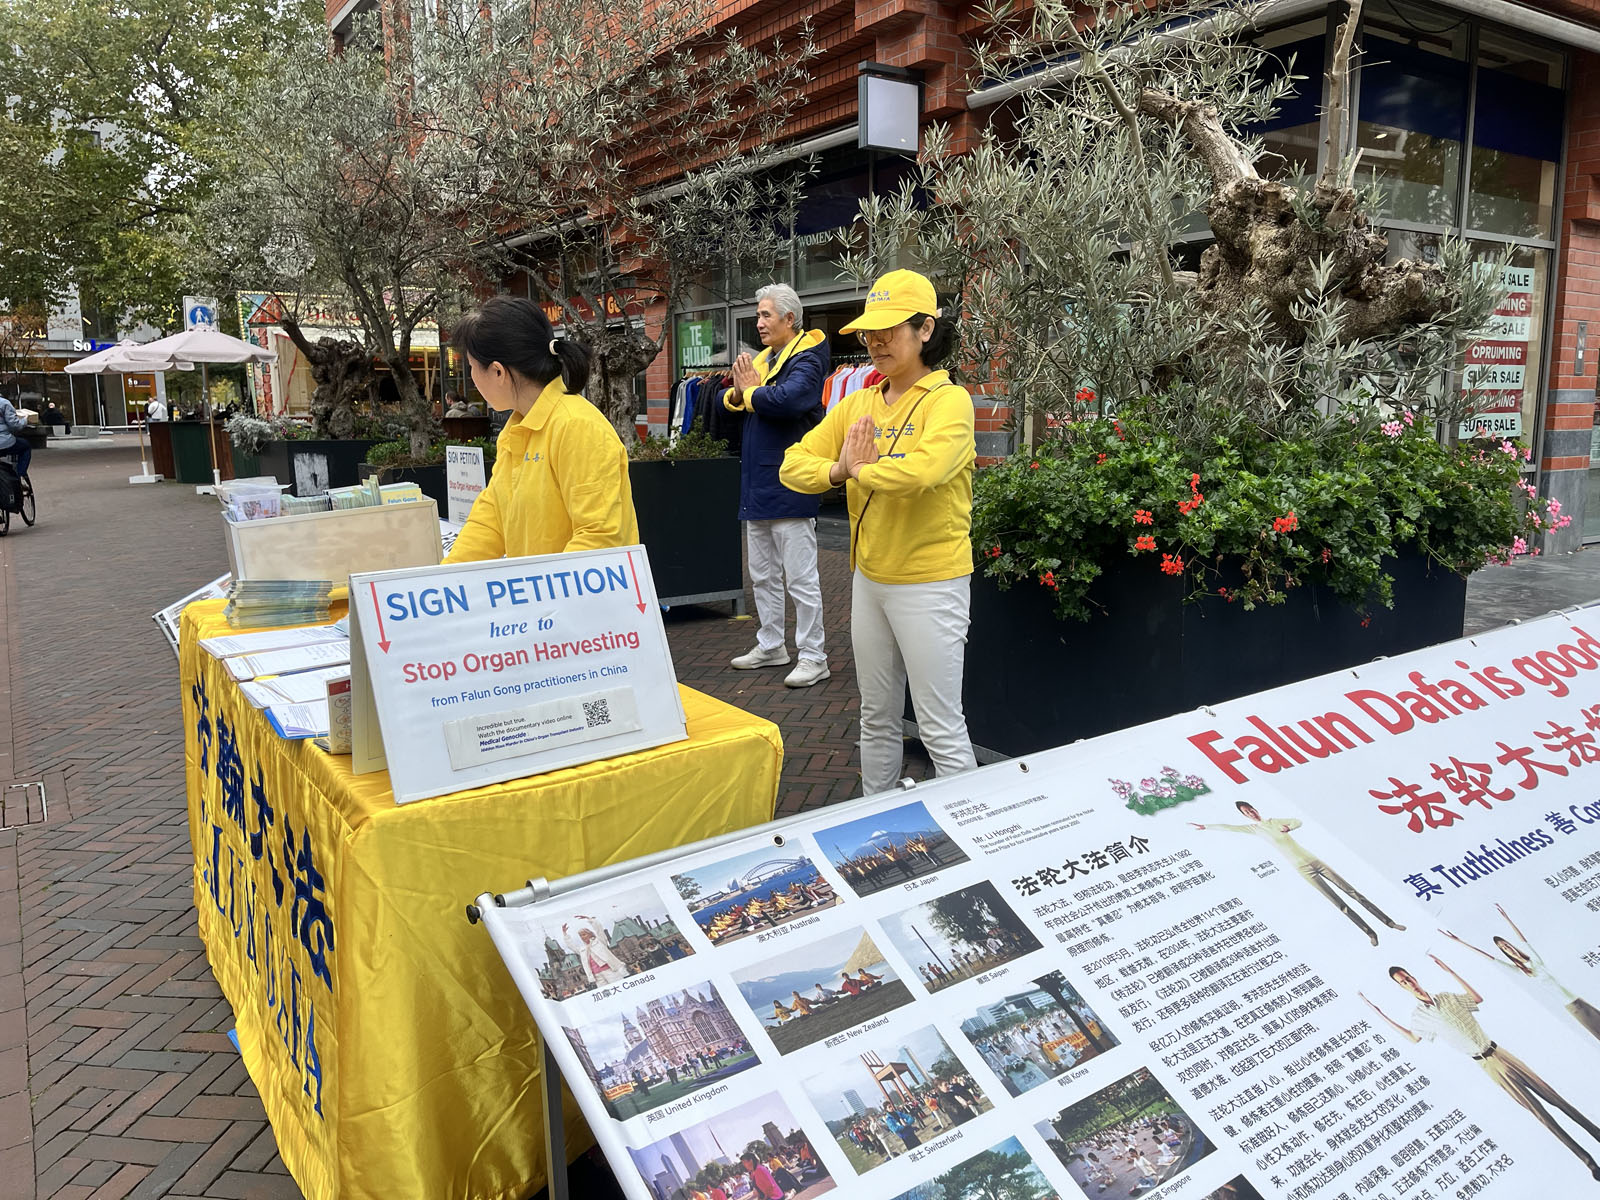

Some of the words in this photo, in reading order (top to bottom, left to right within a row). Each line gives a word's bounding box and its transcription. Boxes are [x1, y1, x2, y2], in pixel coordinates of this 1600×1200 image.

[799, 231, 831, 247] WOMEN
[1508, 273, 1529, 287] SALE
[689, 325, 702, 346] TE
[682, 345, 712, 367] HUUR
[1472, 346, 1522, 360] OPRUIMING
[1500, 371, 1521, 384] SALE
[1494, 418, 1516, 431] SALE
[448, 451, 459, 463] SIGN
[460, 452, 480, 465] PETITION
[386, 585, 469, 621] SIGN
[487, 565, 629, 608] PETITION
[489, 621, 528, 638] here
[537, 617, 554, 631] to
[402, 660, 457, 683] Stop
[463, 648, 529, 673] Organ
[534, 630, 640, 661] Harvesting
[431, 696, 459, 707] from
[461, 689, 491, 702] Falun
[493, 682, 521, 696] Gong
[523, 672, 587, 693] practitioners
[589, 670, 598, 680] in
[600, 664, 628, 676] China
[1187, 715, 1375, 785] Falun
[1343, 670, 1490, 735] Dafa
[1455, 660, 1526, 700] is
[1511, 625, 1600, 698] good
[476, 722, 503, 732] Incredible
[503, 718, 514, 727] but
[478, 730, 495, 739] Watch
[495, 728, 506, 736] the
[505, 721, 541, 733] documentary
[541, 718, 556, 726] video
[556, 714, 573, 722] online
[479, 737, 501, 747] Medical
[501, 731, 527, 742] Genocide
[950, 803, 991, 820] 李洪志先生
[972, 834, 986, 844] Mr.
[984, 830, 994, 839] Li
[992, 824, 1022, 837] Hongzhi
[1011, 835, 1151, 897] 法轮大法简介
[1403, 872, 1446, 902] 真
[1432, 828, 1555, 890] Truthfulness
[1544, 810, 1578, 835] 善
[904, 882, 919, 891] 日本
[920, 875, 939, 885] Japan
[790, 916, 820, 930] Australia
[989, 967, 1009, 978] Saipan
[592, 986, 622, 1002] 加拿大
[623, 974, 655, 989] Canada
[846, 1030, 862, 1038] New
[862, 1016, 889, 1032] Zealand
[1071, 1068, 1089, 1080] Korea
[646, 1110, 665, 1124] 英国
[665, 1099, 692, 1115] United
[692, 1084, 728, 1103] Kingdom
[908, 1149, 926, 1163] 瑞士
[924, 1130, 964, 1155] Switzerland
[1160, 1174, 1192, 1196] Singapore
